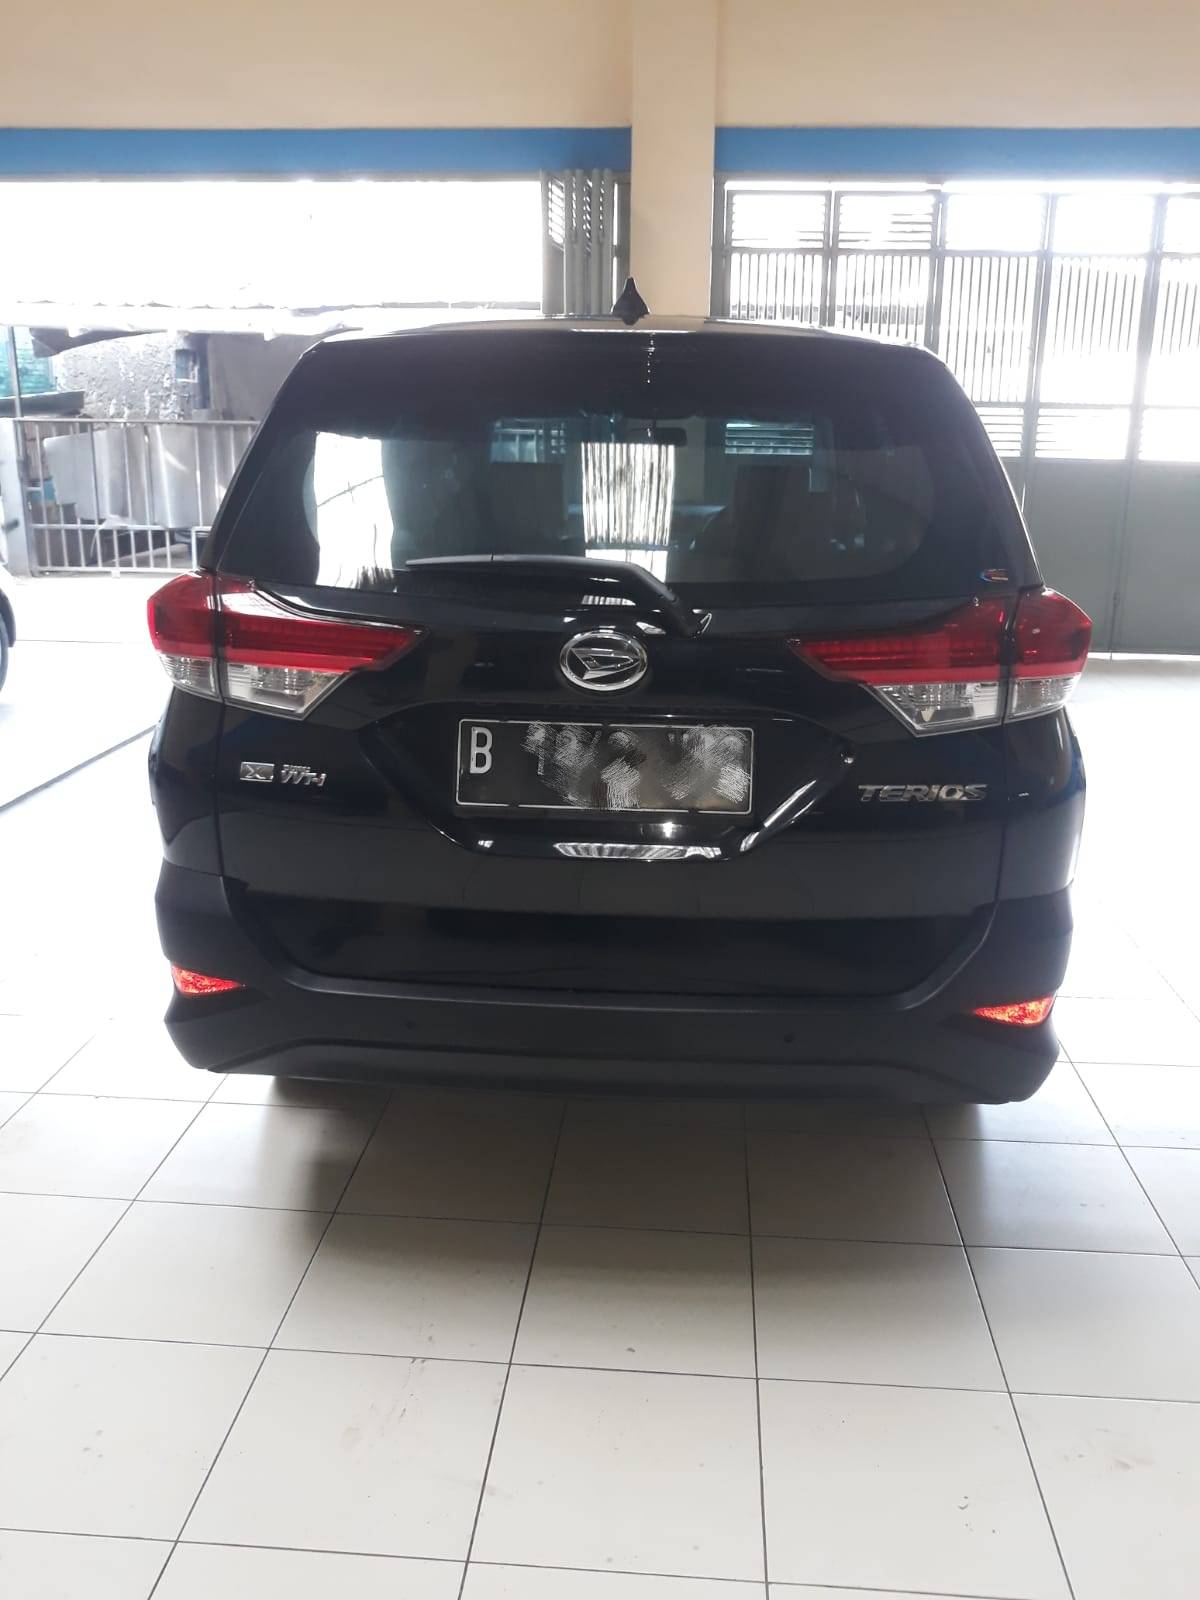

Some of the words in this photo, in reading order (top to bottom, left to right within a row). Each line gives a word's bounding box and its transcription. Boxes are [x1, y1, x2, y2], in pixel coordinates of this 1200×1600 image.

[469, 726, 493, 774] B
[242, 763, 270, 781] X
[858, 784, 987, 801] TERIOS
